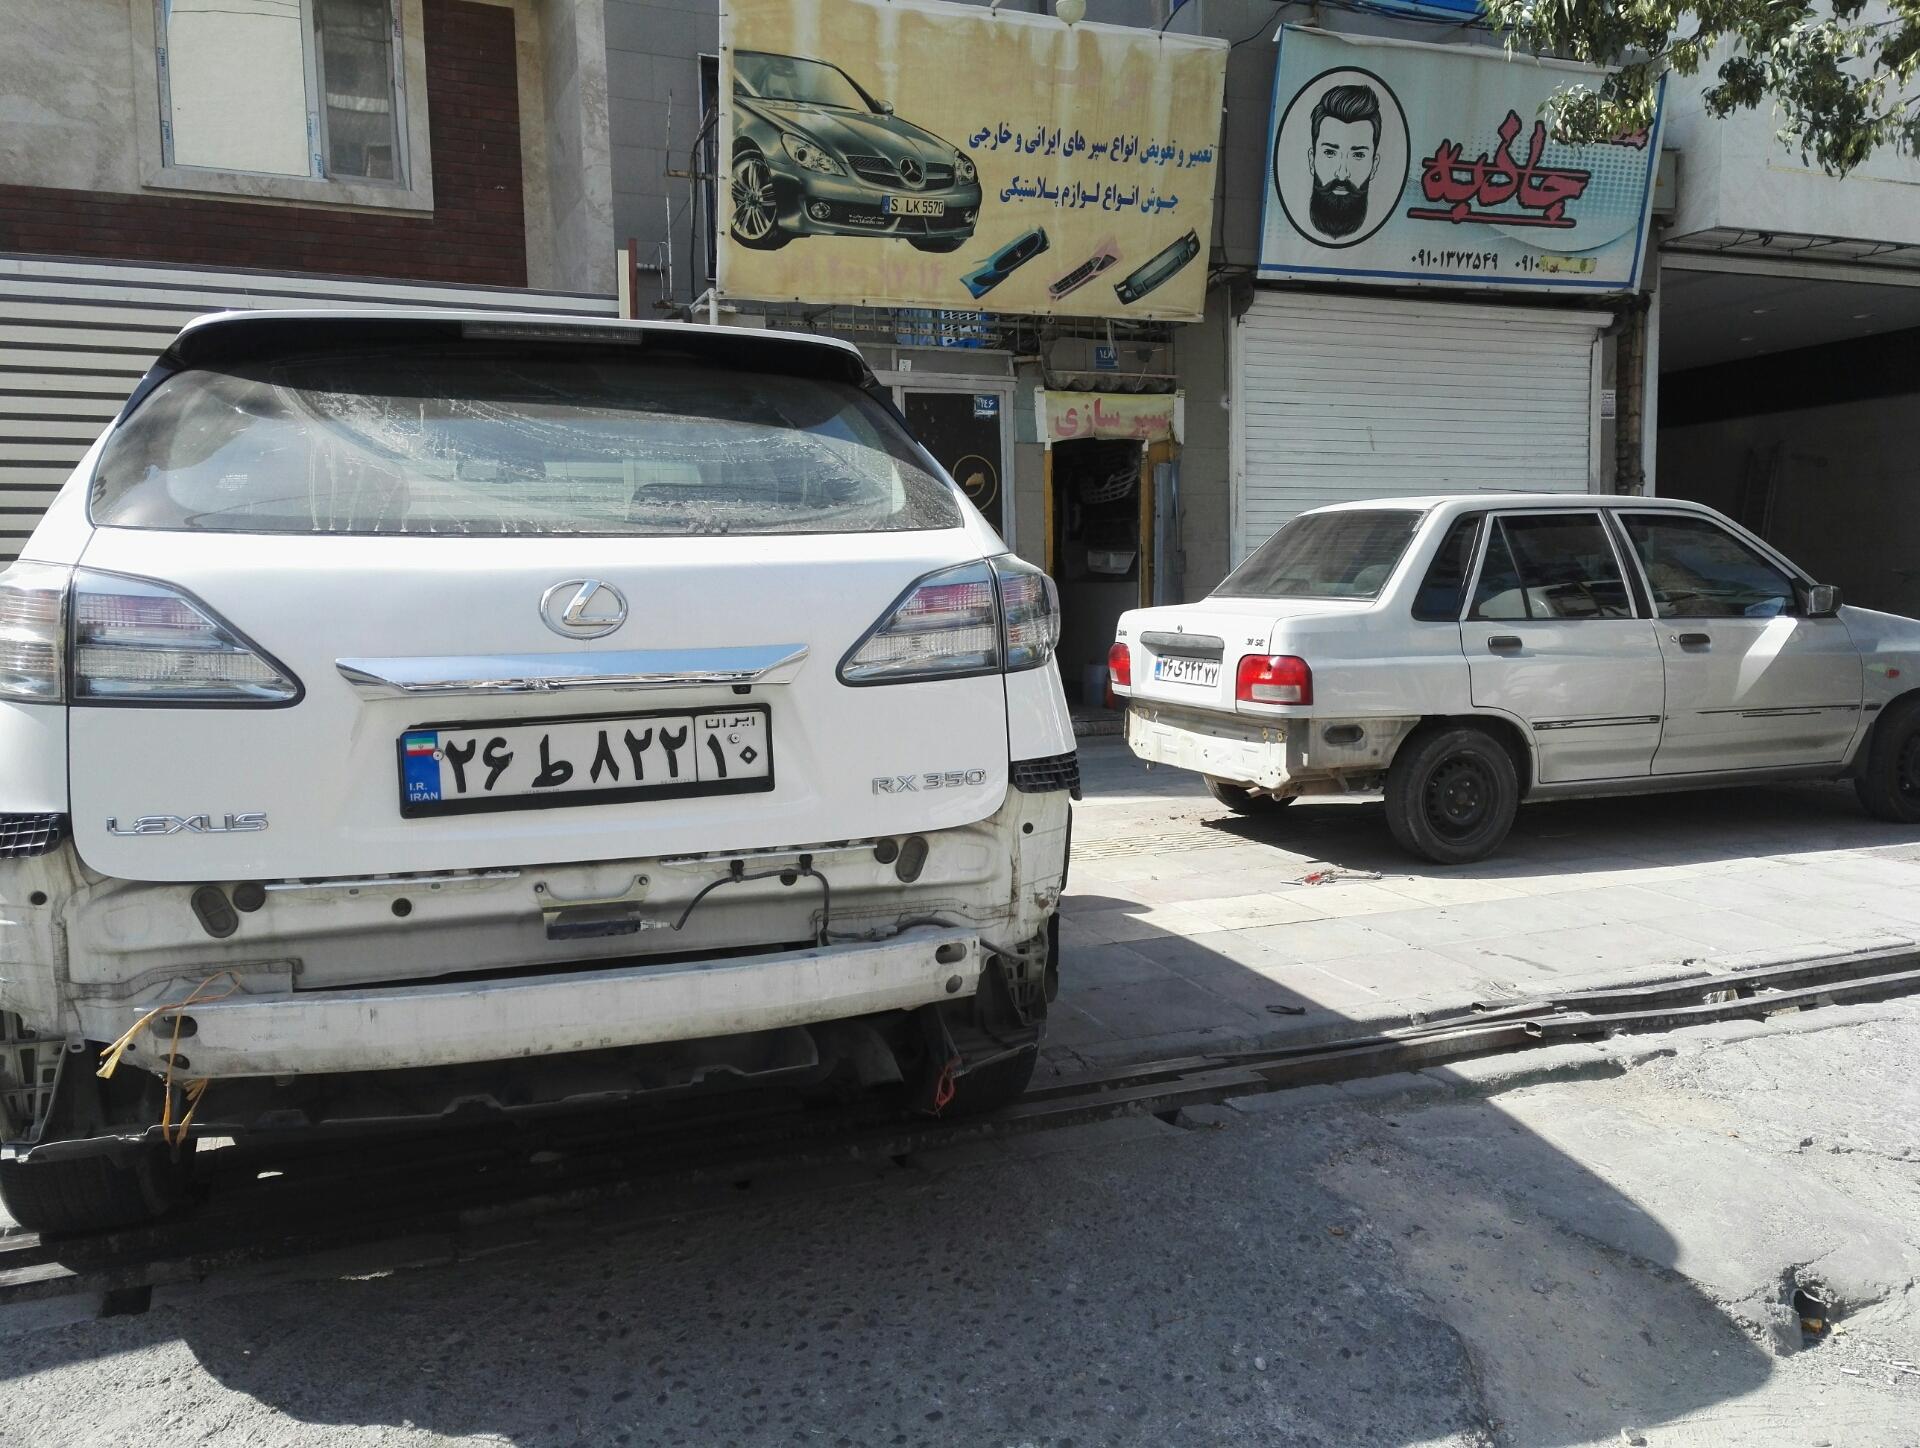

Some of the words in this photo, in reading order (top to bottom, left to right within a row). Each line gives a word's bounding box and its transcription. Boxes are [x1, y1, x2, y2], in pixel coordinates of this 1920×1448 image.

[968, 121, 1012, 150] خارجی
[1015, 132, 1022, 152] و
[1024, 125, 1061, 156] ایرانی
[1062, 129, 1086, 157] های
[1109, 134, 1139, 162] انواع
[1087, 139, 1108, 160] سپر
[1139, 138, 1176, 166] تعویض
[1176, 147, 1184, 167] و
[1186, 143, 1214, 168] تعمیر
[1407, 109, 1592, 228] جاذبه
[1000, 175, 1059, 207] پلاستیکی
[1061, 181, 1100, 208] لوازم
[1102, 184, 1140, 211] انواع
[1140, 187, 1179, 214] جوش
[905, 199, 921, 214] LK
[922, 200, 944, 215] 5570
[1055, 397, 1121, 437] سازی
[705, 714, 756, 730] ایران
[408, 782, 428, 792] I.R.
[872, 774, 920, 796] RX
[922, 768, 987, 791] 350
[409, 791, 439, 802] IRAN
[106, 812, 269, 837] LEXUS
